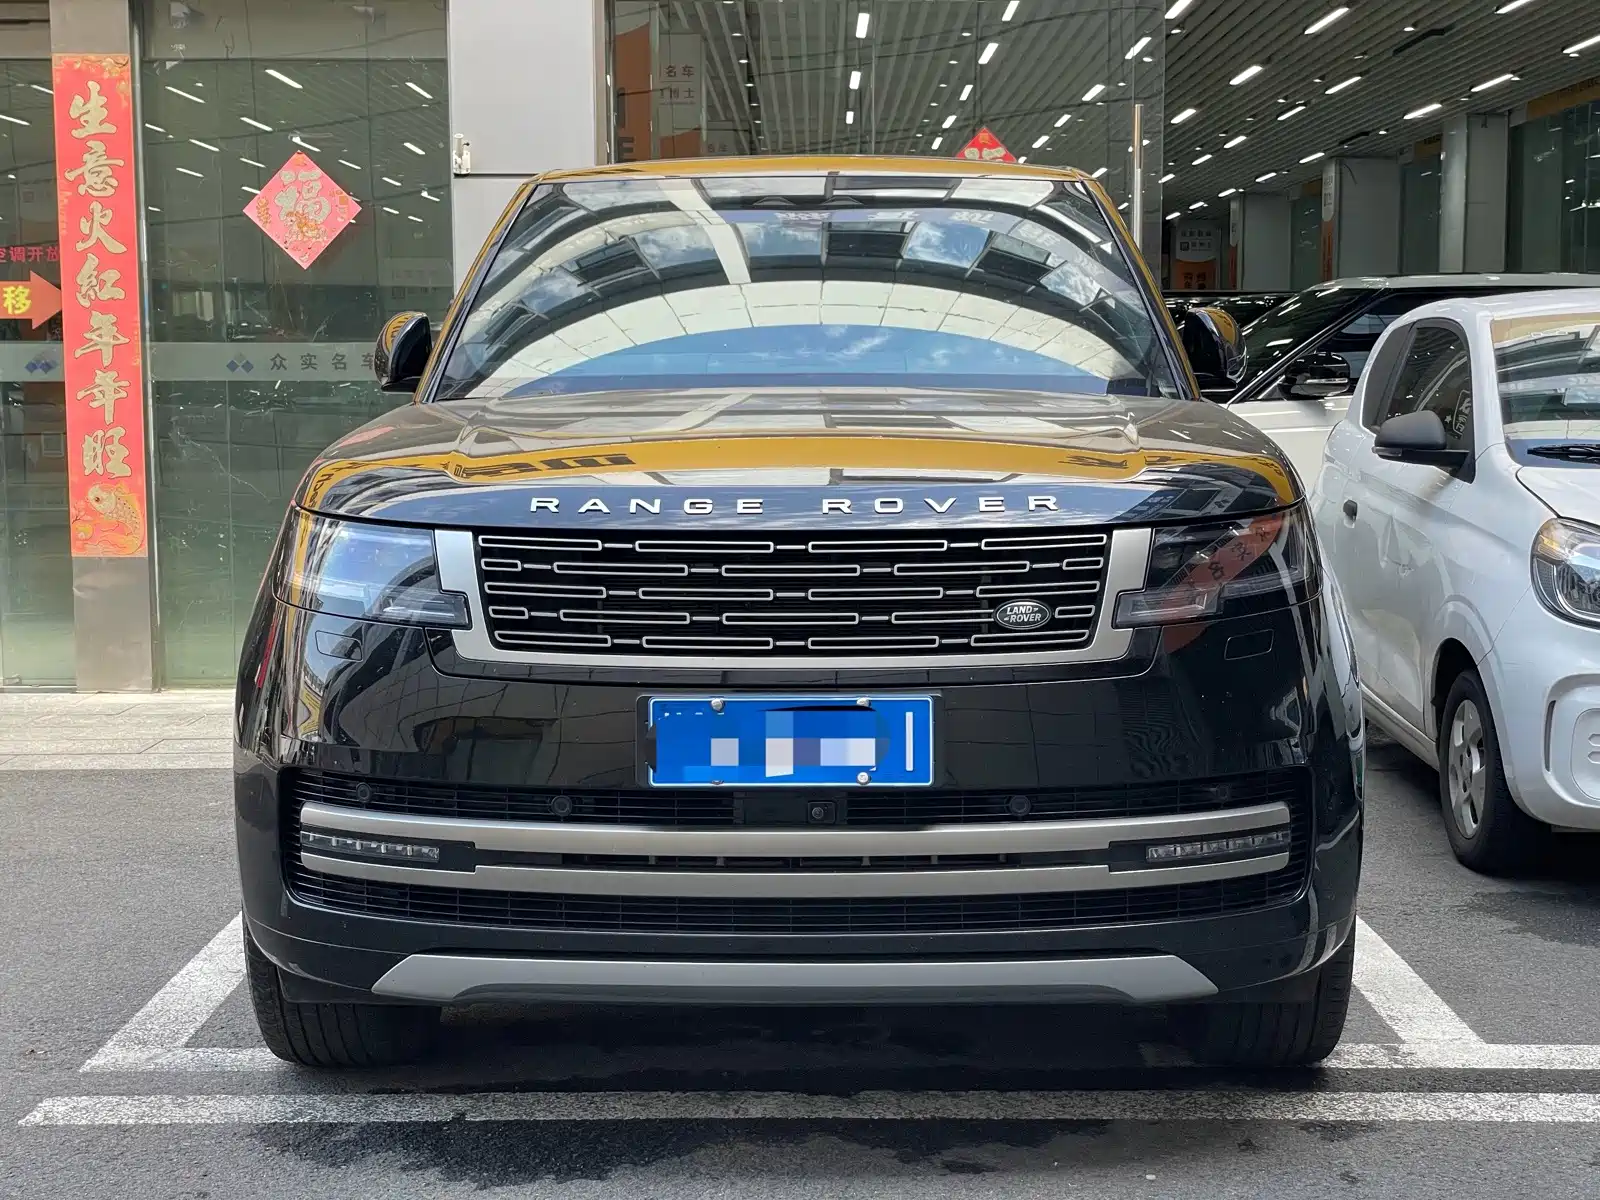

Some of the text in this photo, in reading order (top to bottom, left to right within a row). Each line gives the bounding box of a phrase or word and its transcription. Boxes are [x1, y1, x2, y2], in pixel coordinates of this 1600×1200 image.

[275, 170, 332, 225] 福
[530, 495, 1058, 514] RANGE ROVER
[1007, 606, 1032, 614] LAND
[1009, 614, 1041, 622] ROVER
